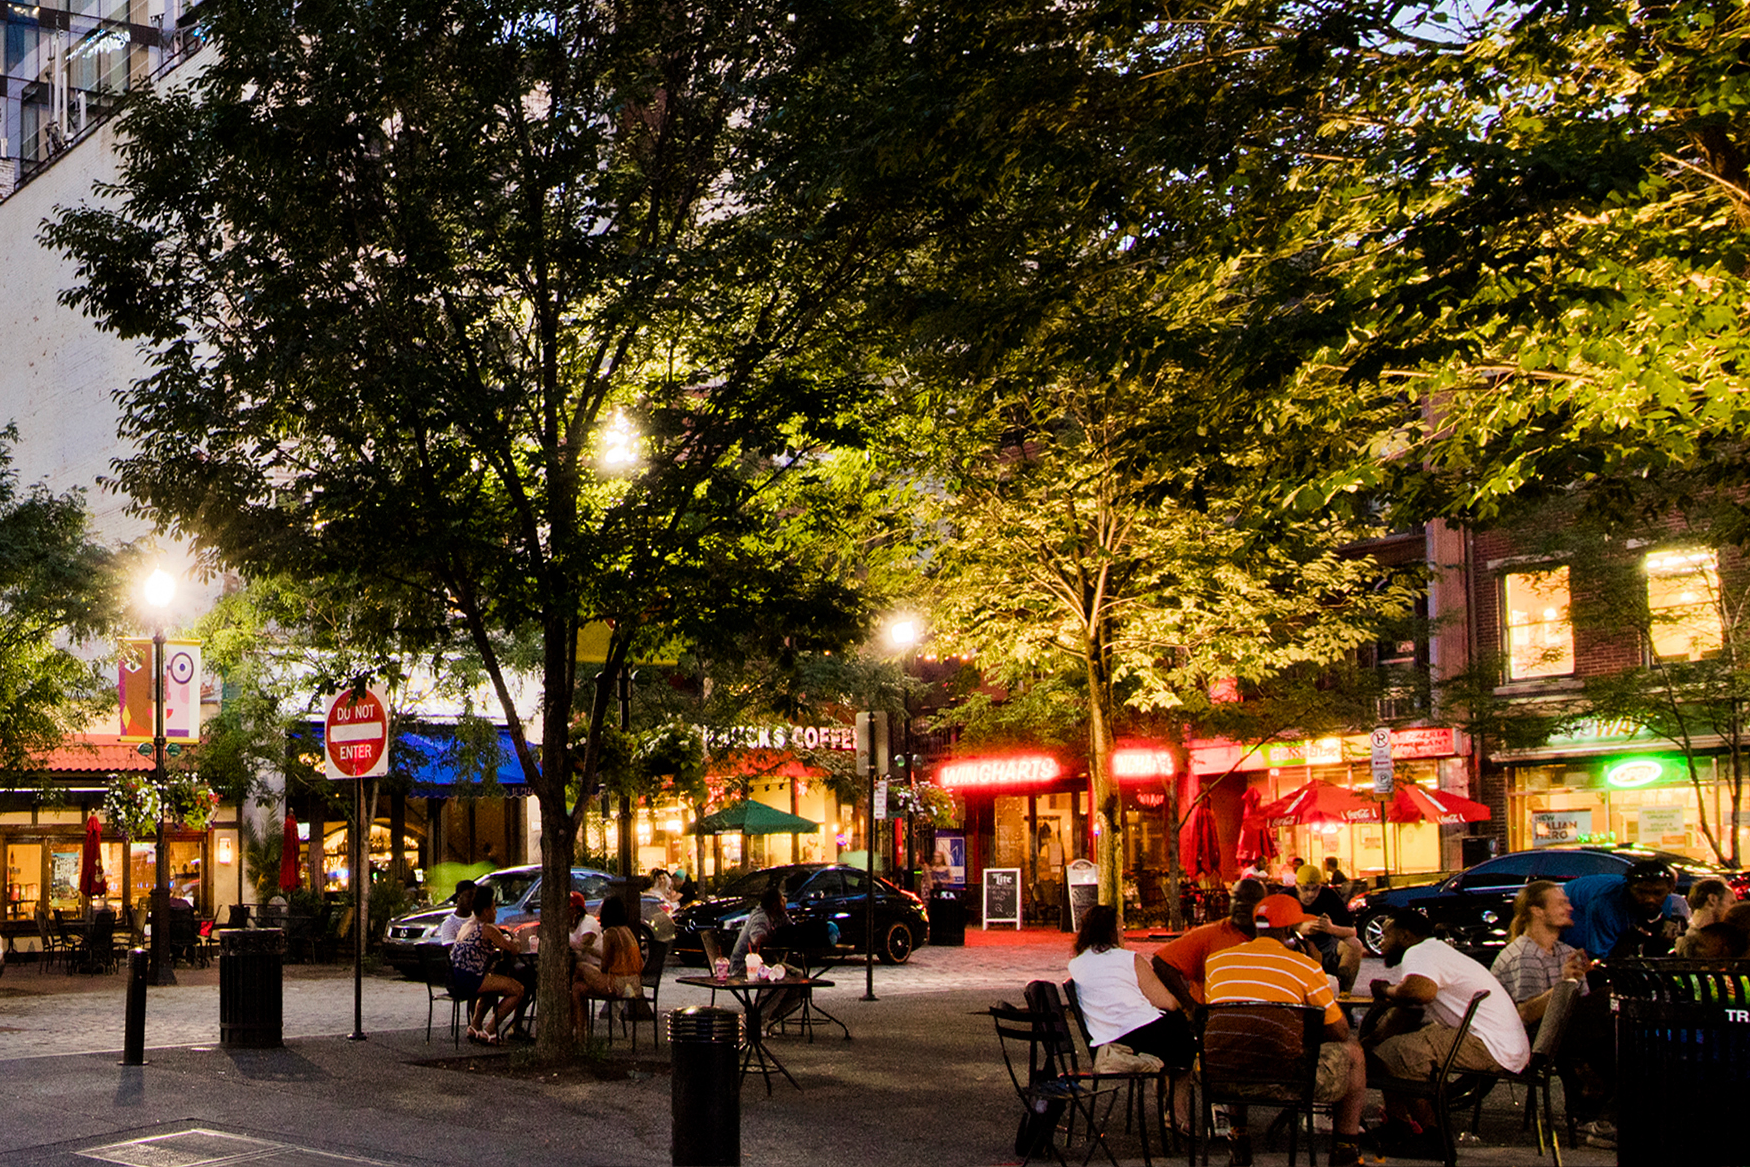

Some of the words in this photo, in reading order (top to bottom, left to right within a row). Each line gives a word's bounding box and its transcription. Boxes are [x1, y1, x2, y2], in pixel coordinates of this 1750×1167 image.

[355, 704, 375, 719] NOT
[340, 745, 372, 760] ENTER
[1725, 1008, 1750, 1023] TR
